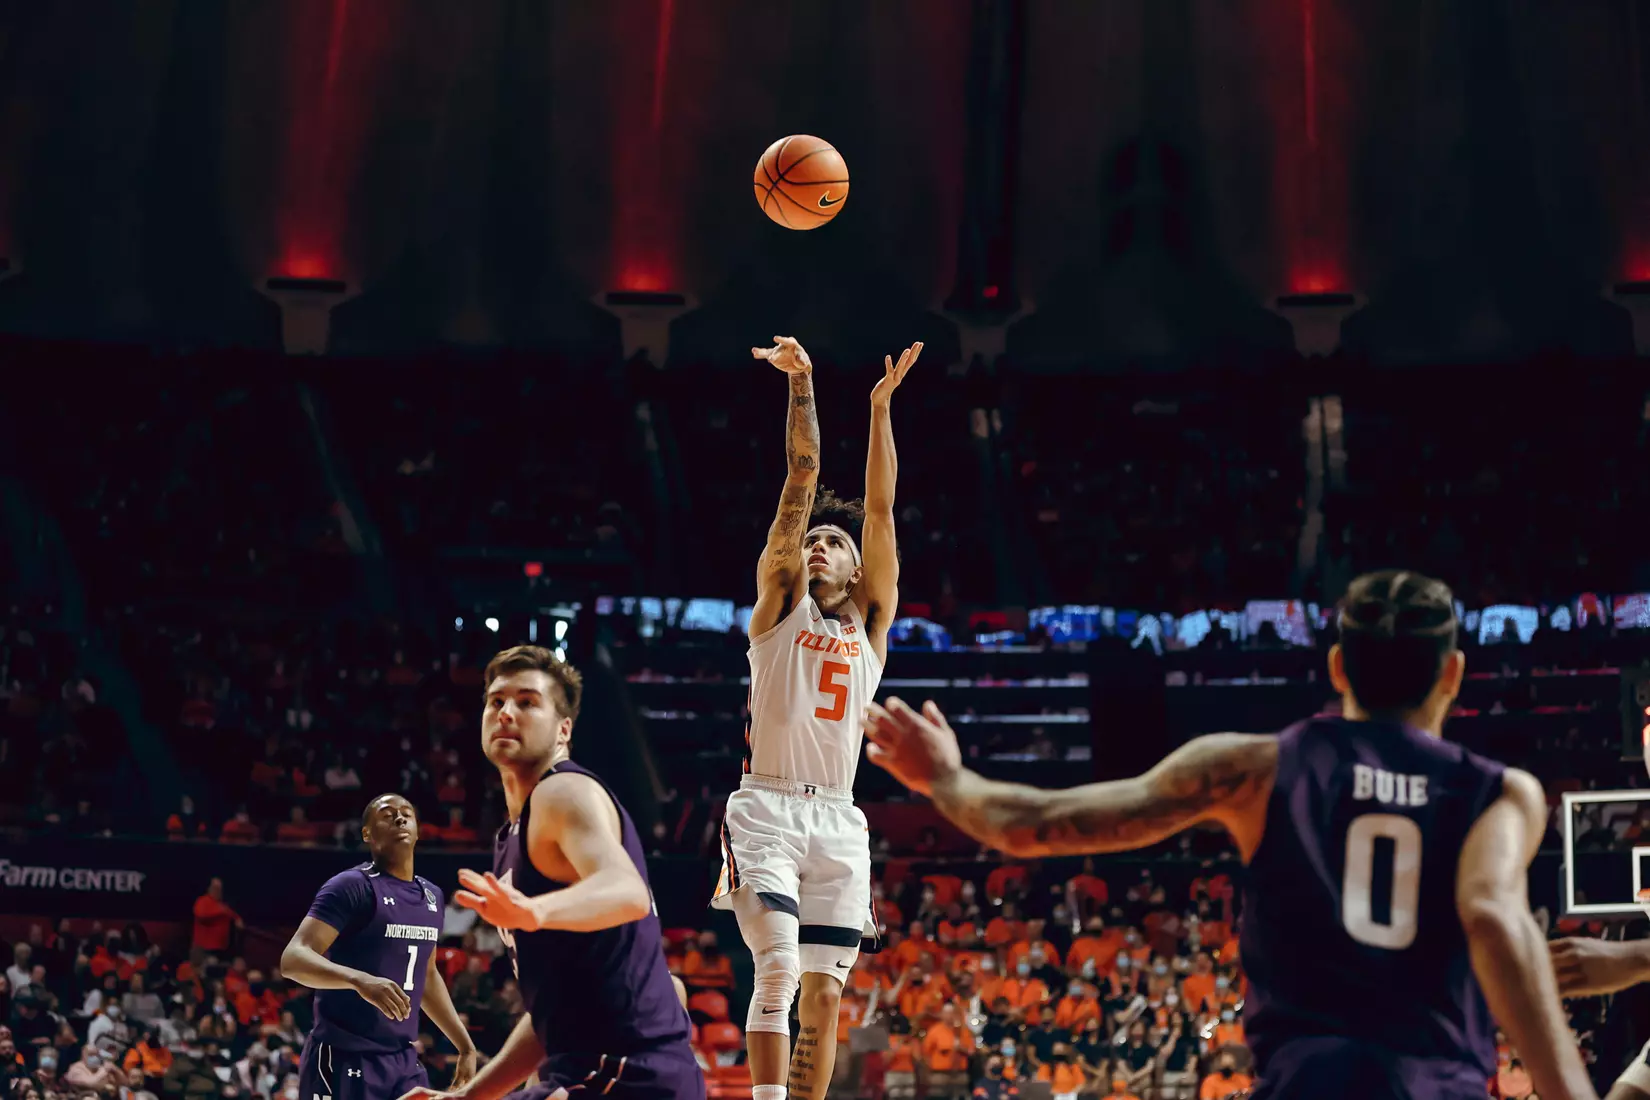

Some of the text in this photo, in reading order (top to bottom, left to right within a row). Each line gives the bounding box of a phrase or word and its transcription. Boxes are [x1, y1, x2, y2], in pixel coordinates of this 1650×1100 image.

[814, 660, 851, 722] 5
[1352, 763, 1430, 807] BUIE
[59, 868, 142, 892] CENTER
[1342, 812, 1422, 951] 0
[403, 945, 418, 991] 1
